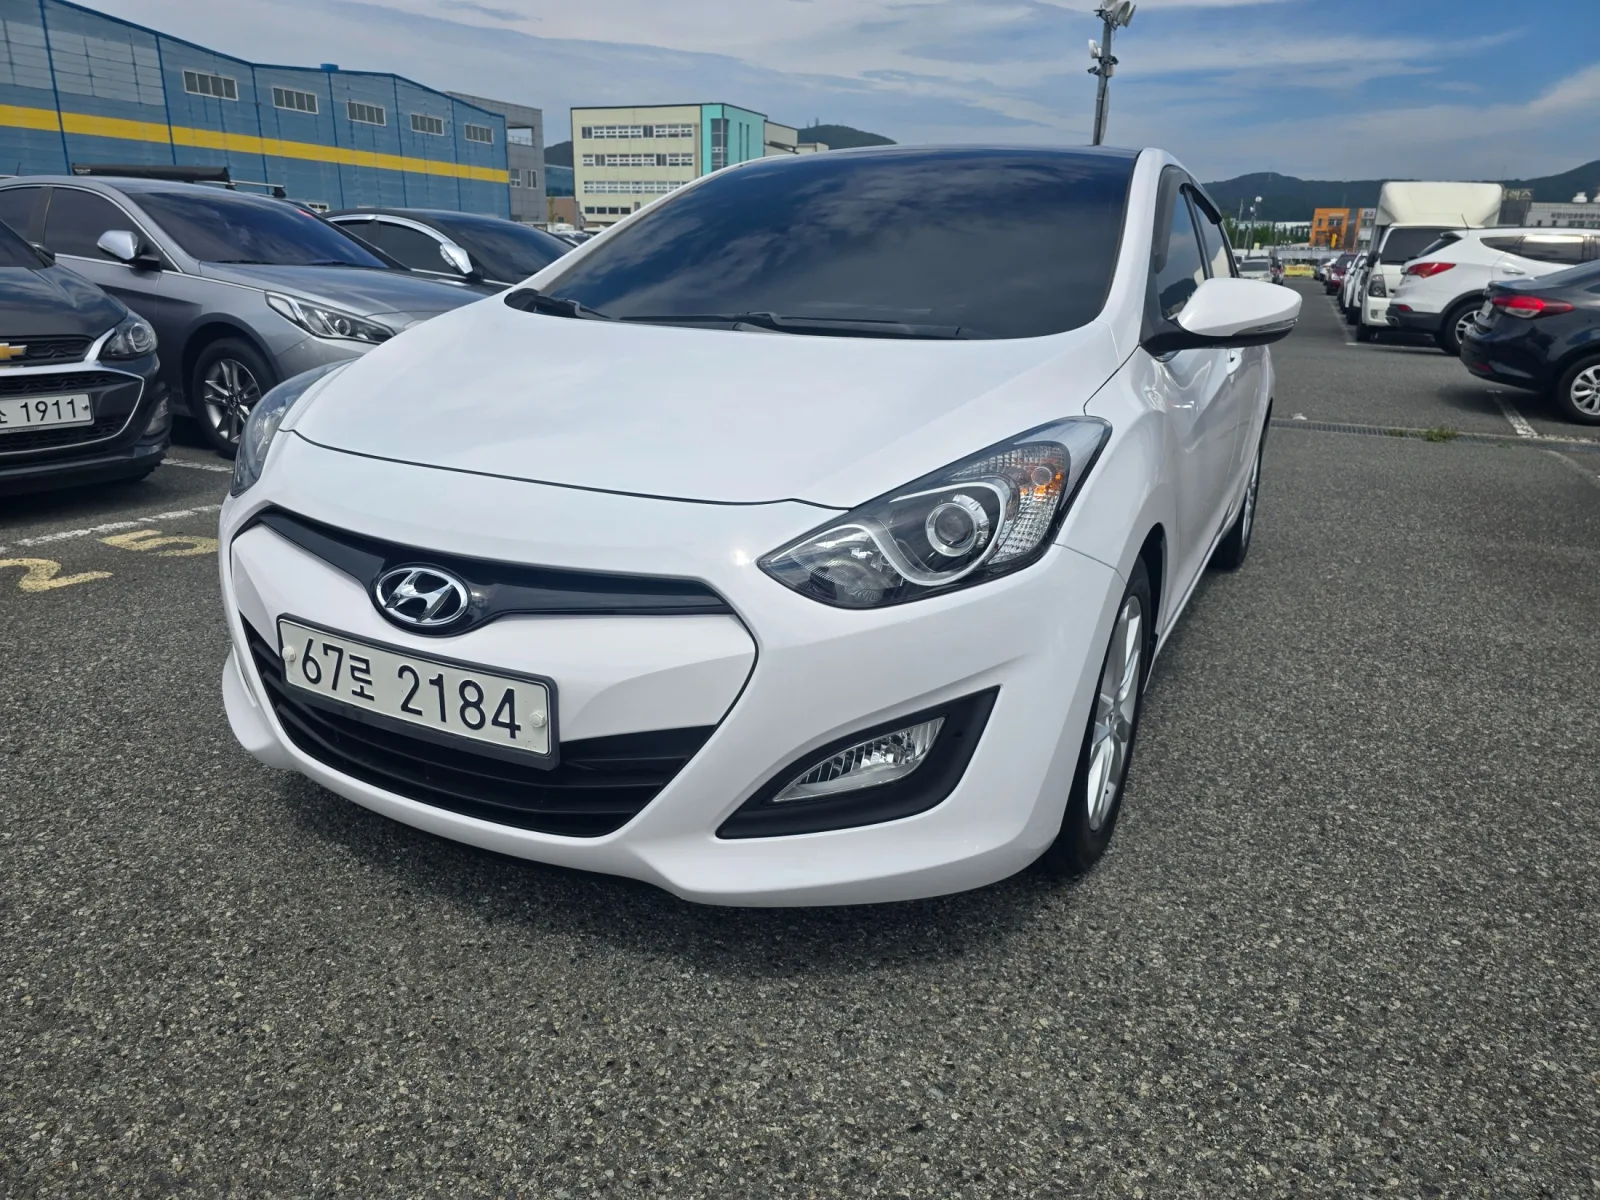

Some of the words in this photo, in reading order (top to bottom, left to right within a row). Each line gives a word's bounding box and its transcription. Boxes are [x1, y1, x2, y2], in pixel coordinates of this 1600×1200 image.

[20, 398, 77, 422] 1911
[301, 638, 375, 702] 67로
[397, 664, 521, 739] 2184
